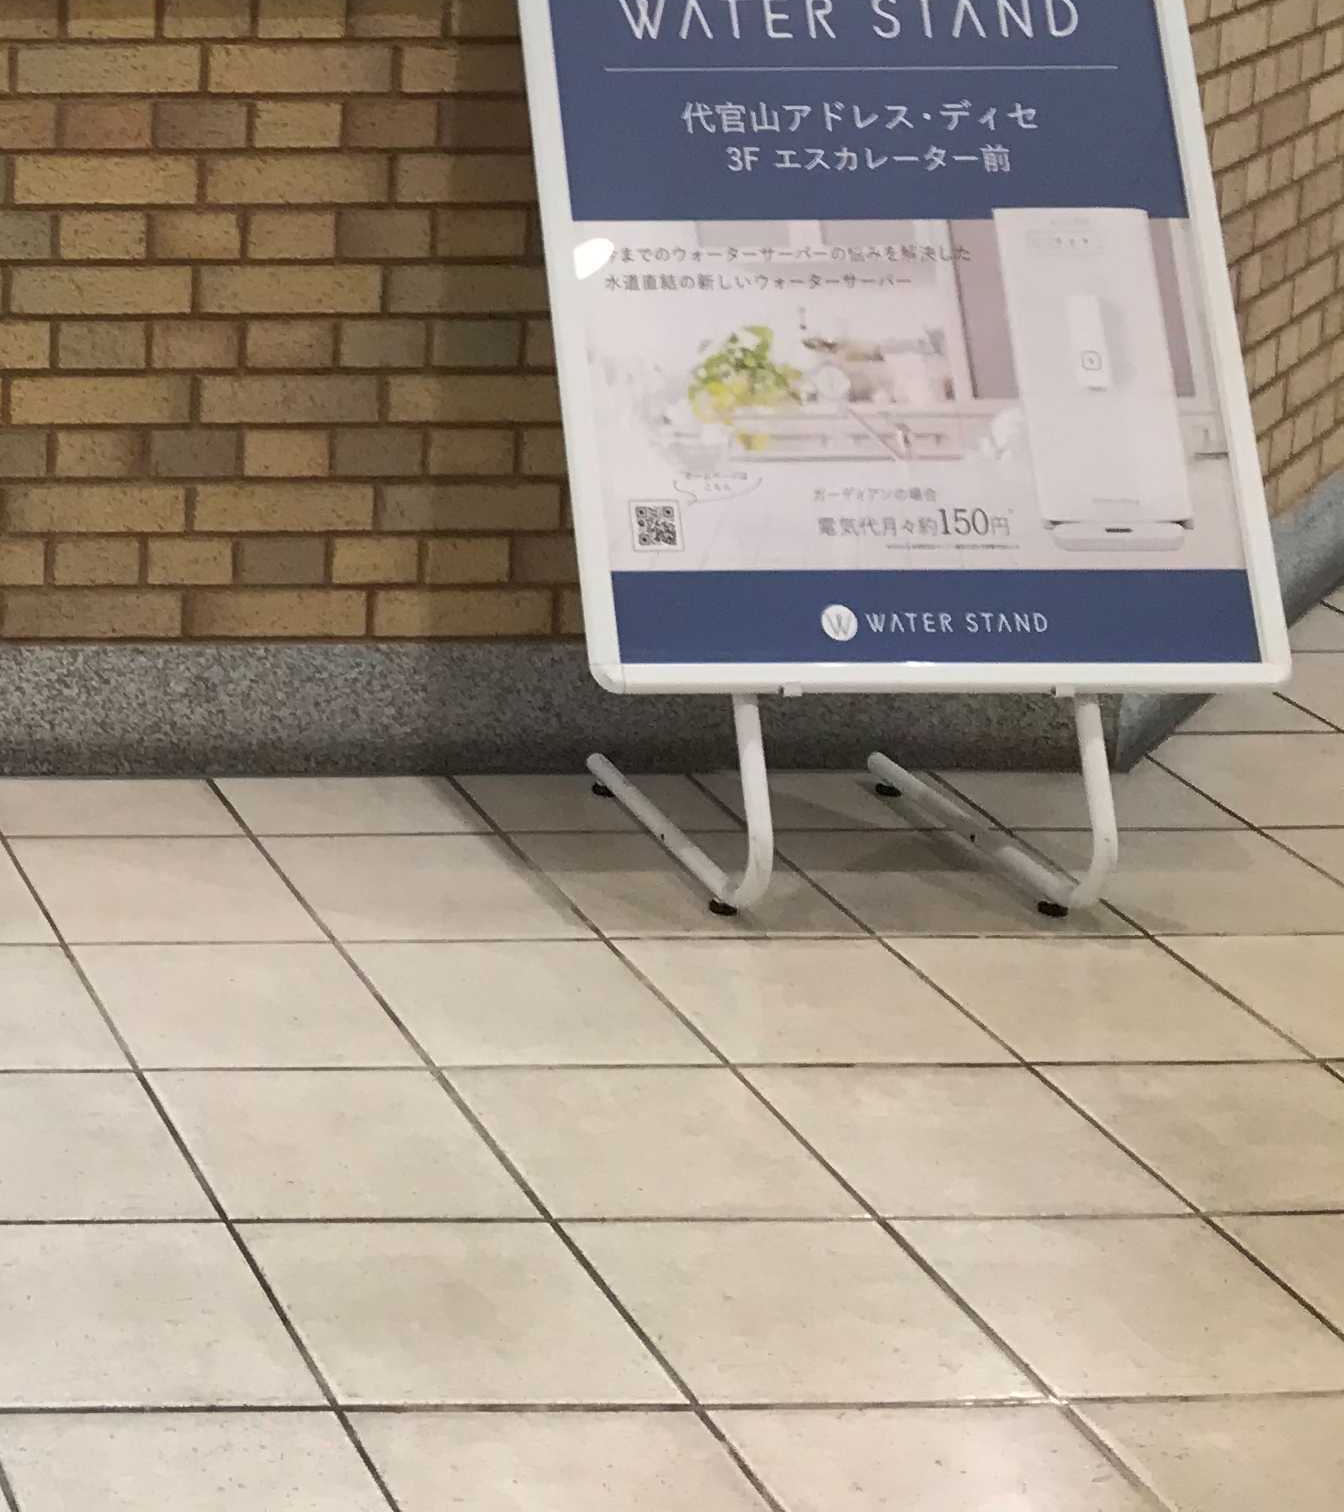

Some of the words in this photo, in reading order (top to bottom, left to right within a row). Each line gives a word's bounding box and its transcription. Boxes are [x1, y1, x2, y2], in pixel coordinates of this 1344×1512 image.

[680, 101, 1040, 135] 代官山アドレス・ディセ
[726, 146, 759, 173] 3F
[775, 144, 1012, 174] エスカレーター前
[610, 245, 972, 264] までのウォーターサーバーの悩みを解決した
[866, 613, 953, 635] WATER
[966, 612, 1048, 634] STAND
